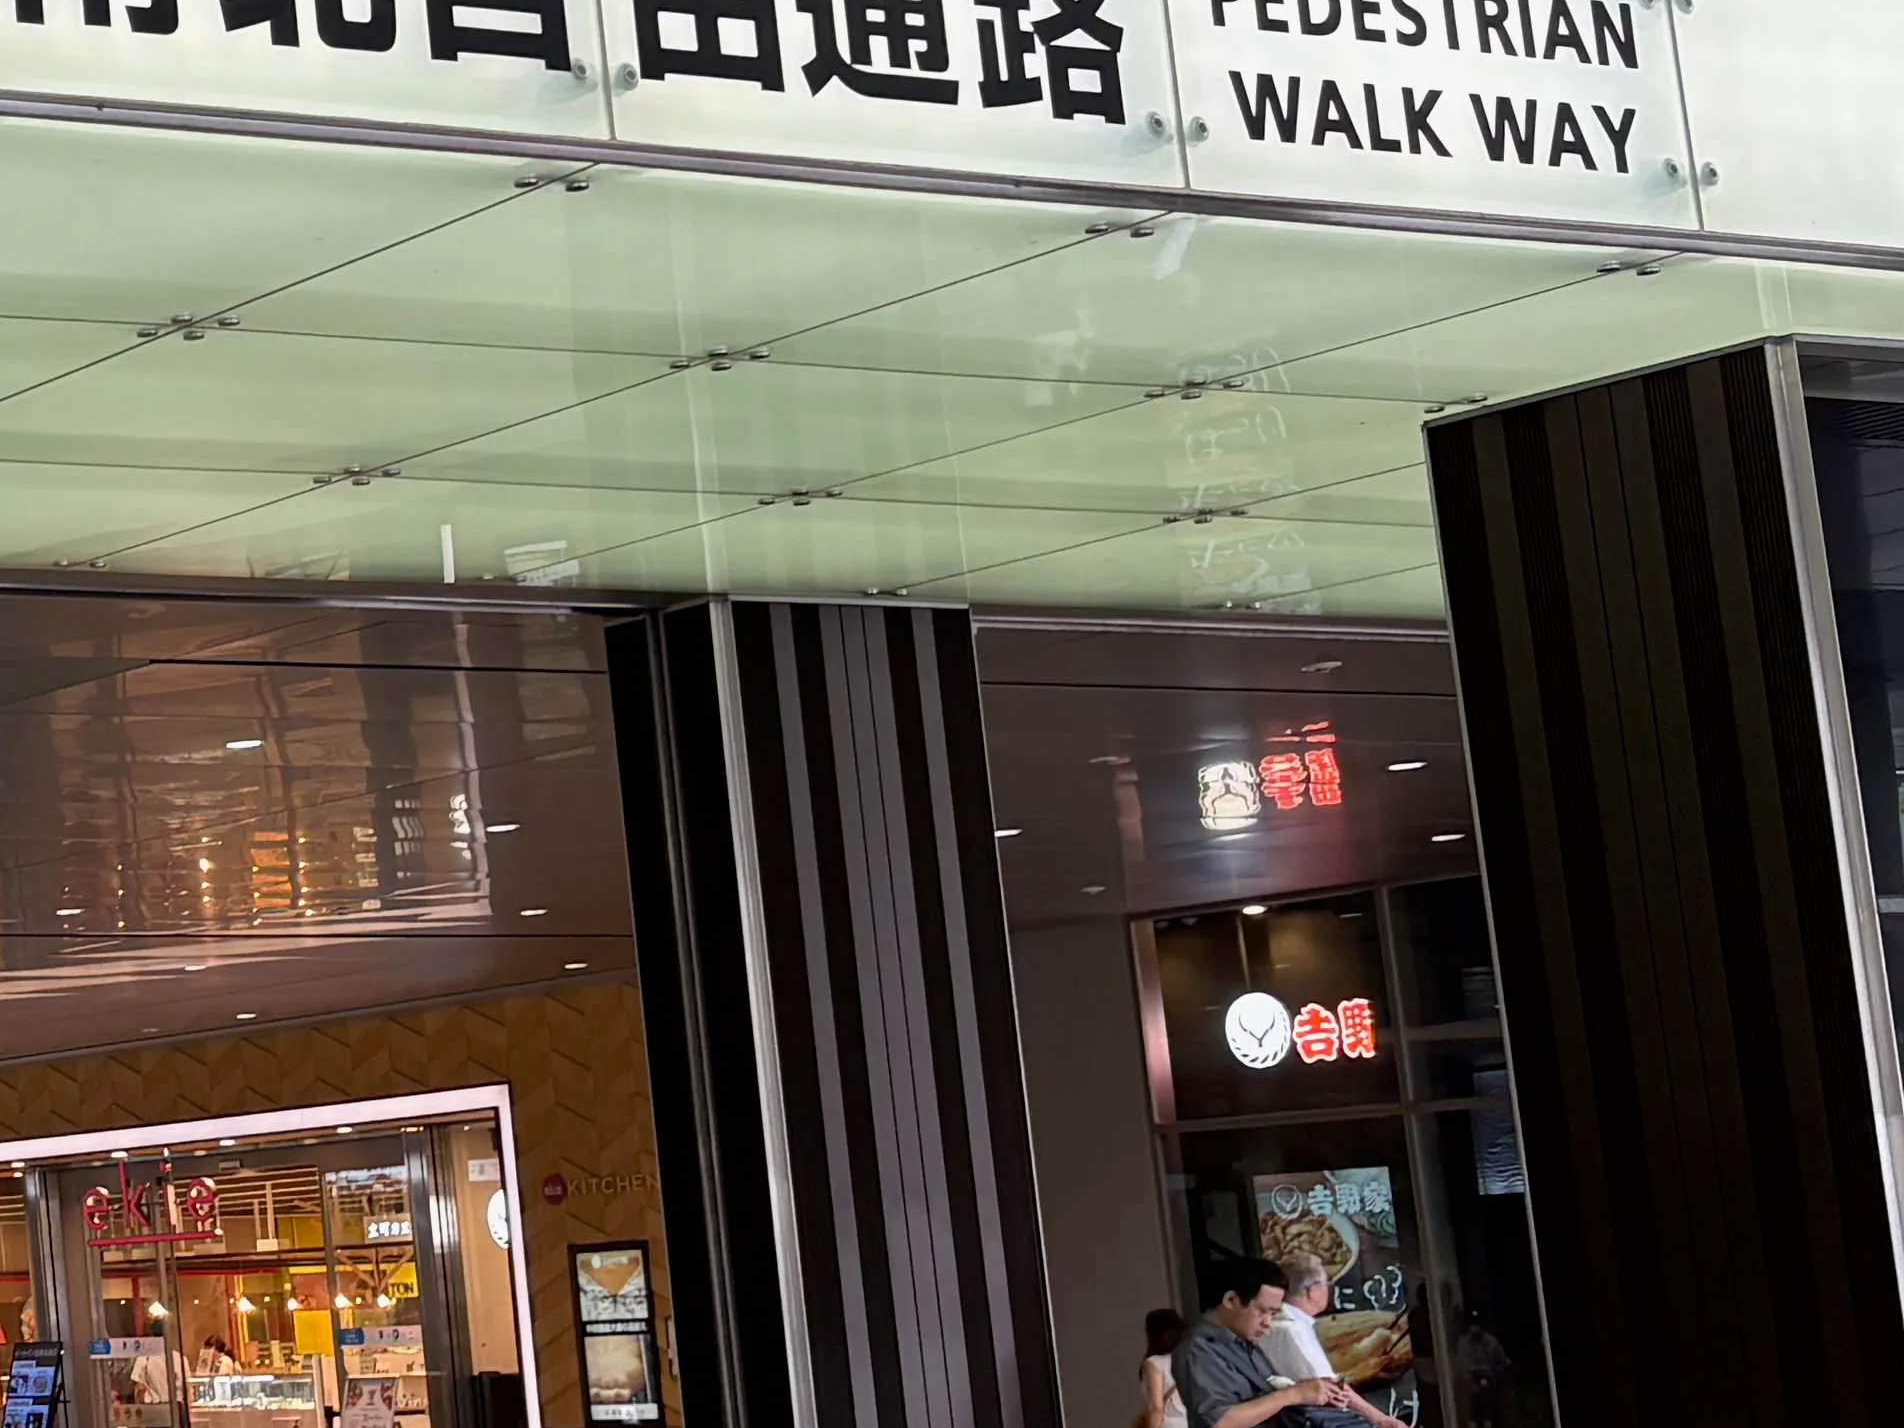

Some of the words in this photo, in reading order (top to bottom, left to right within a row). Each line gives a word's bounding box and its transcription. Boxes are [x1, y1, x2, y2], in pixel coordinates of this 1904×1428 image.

[1228, 70, 1452, 157] WALK
[1468, 93, 1636, 174] WAY
[83, 1157, 216, 1232] ekie
[567, 1173, 659, 1198] KITCHEN
[1308, 1183, 1391, 1217] 吉野家
